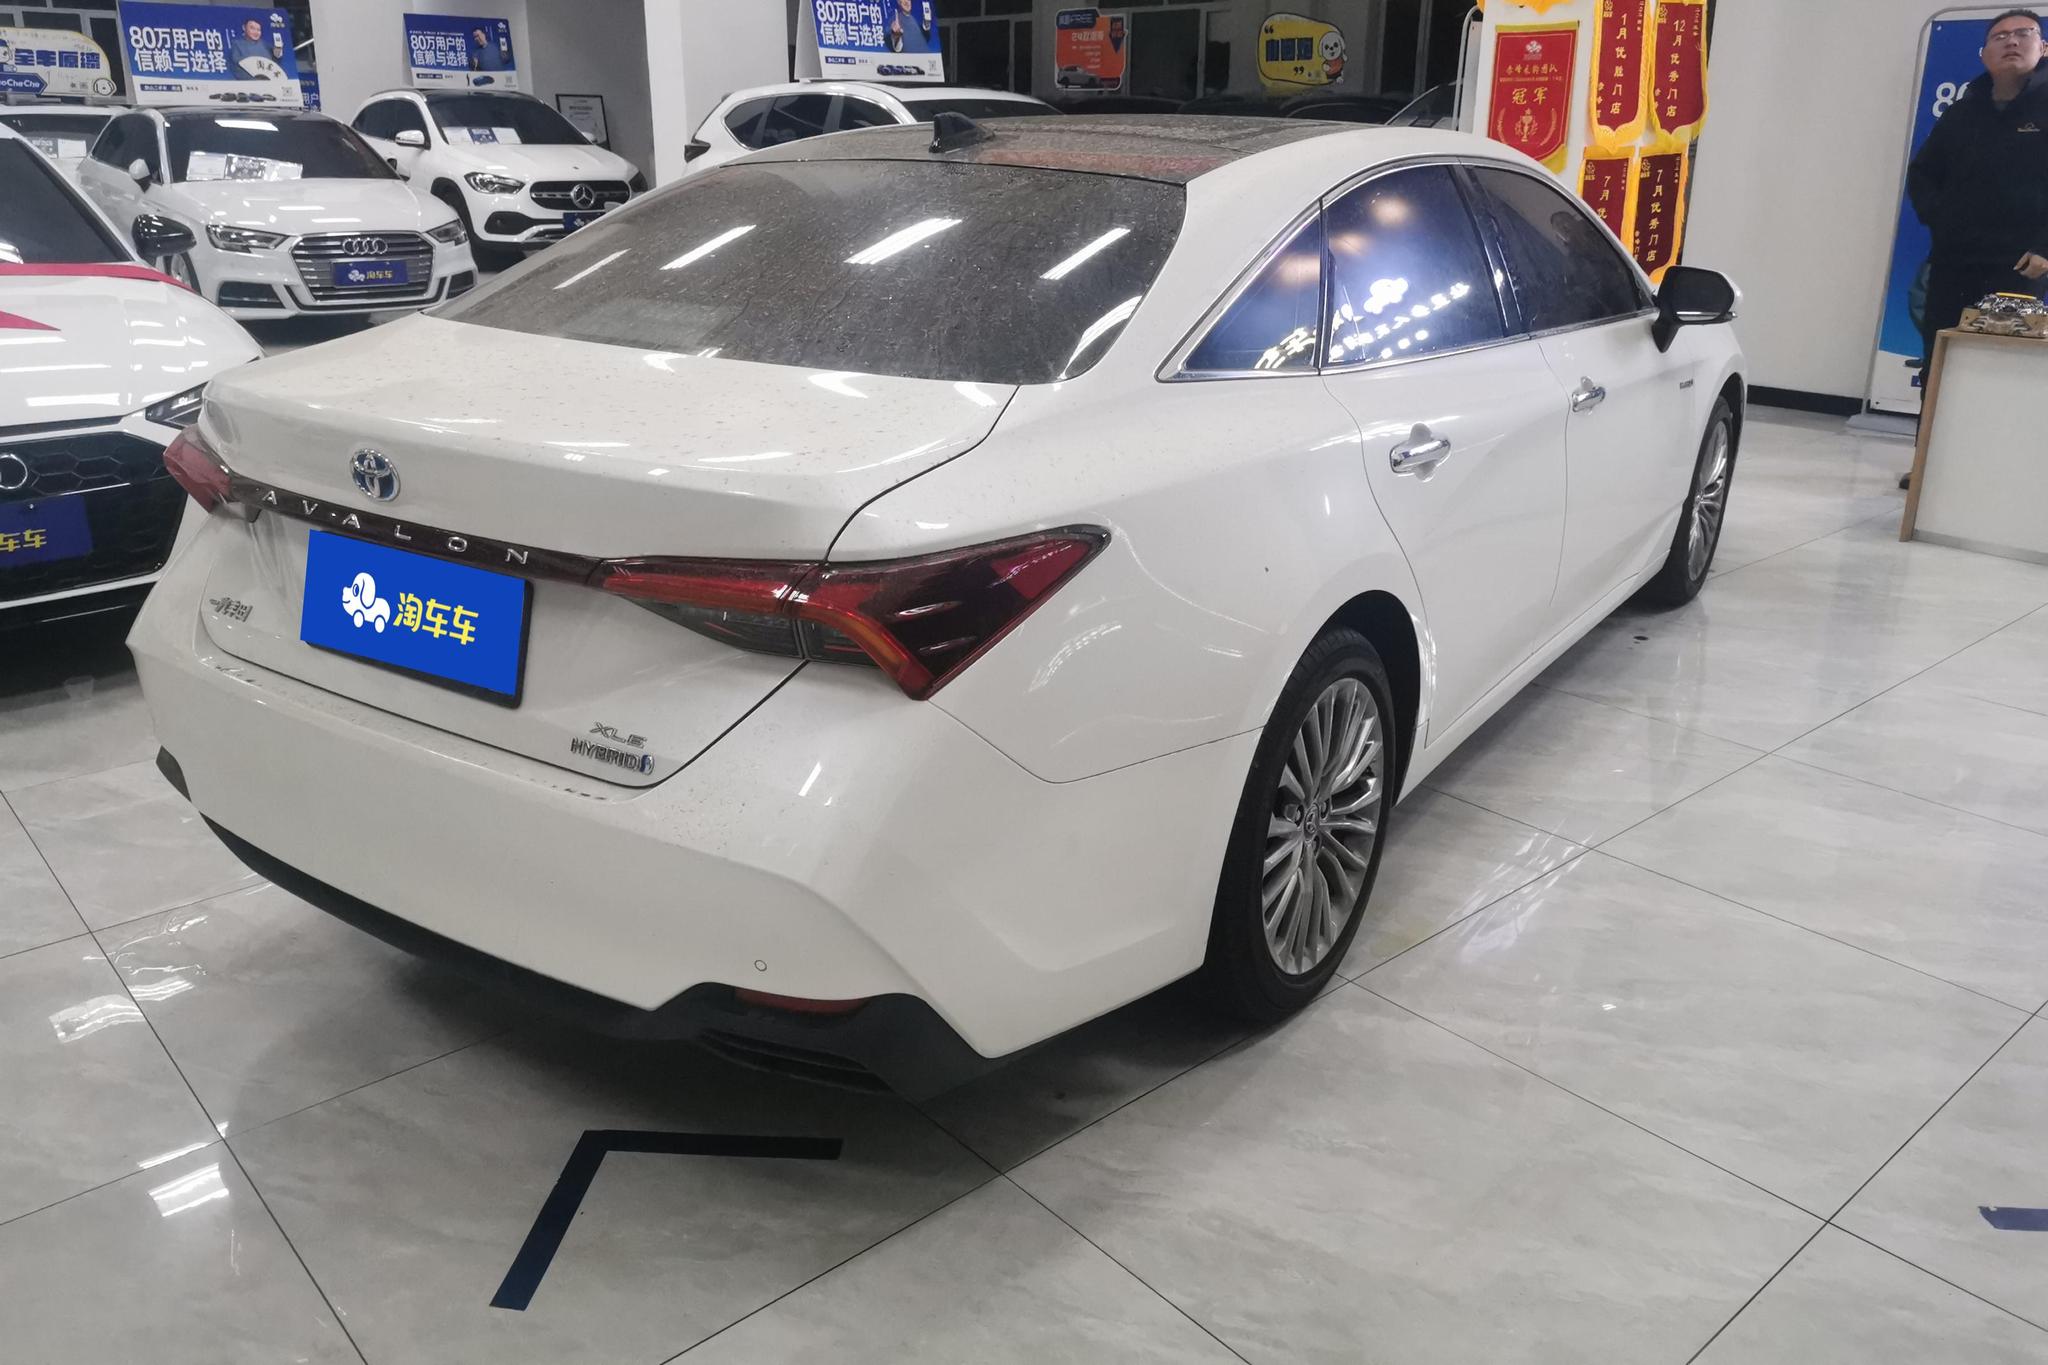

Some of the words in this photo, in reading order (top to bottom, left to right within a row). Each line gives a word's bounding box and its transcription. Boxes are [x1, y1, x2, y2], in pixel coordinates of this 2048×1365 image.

[816, 0, 882, 24] 80万用户的
[129, 25, 223, 51] 80万用户的
[410, 35, 466, 51] 80万用户的
[820, 22, 885, 47] 信赖与选择
[134, 49, 227, 73] 信赖与选择
[413, 50, 469, 67] 信赖与选择
[1666, 19, 1686, 117] 12月优秀门店
[0, 78, 40, 88] oCheChe
[1512, 86, 1548, 105] 冠军
[1646, 169, 1663, 262] 7月优秀门店
[262, 490, 529, 565] AVALON
[589, 721, 647, 749] XLE
[570, 737, 641, 772] HYBRID
